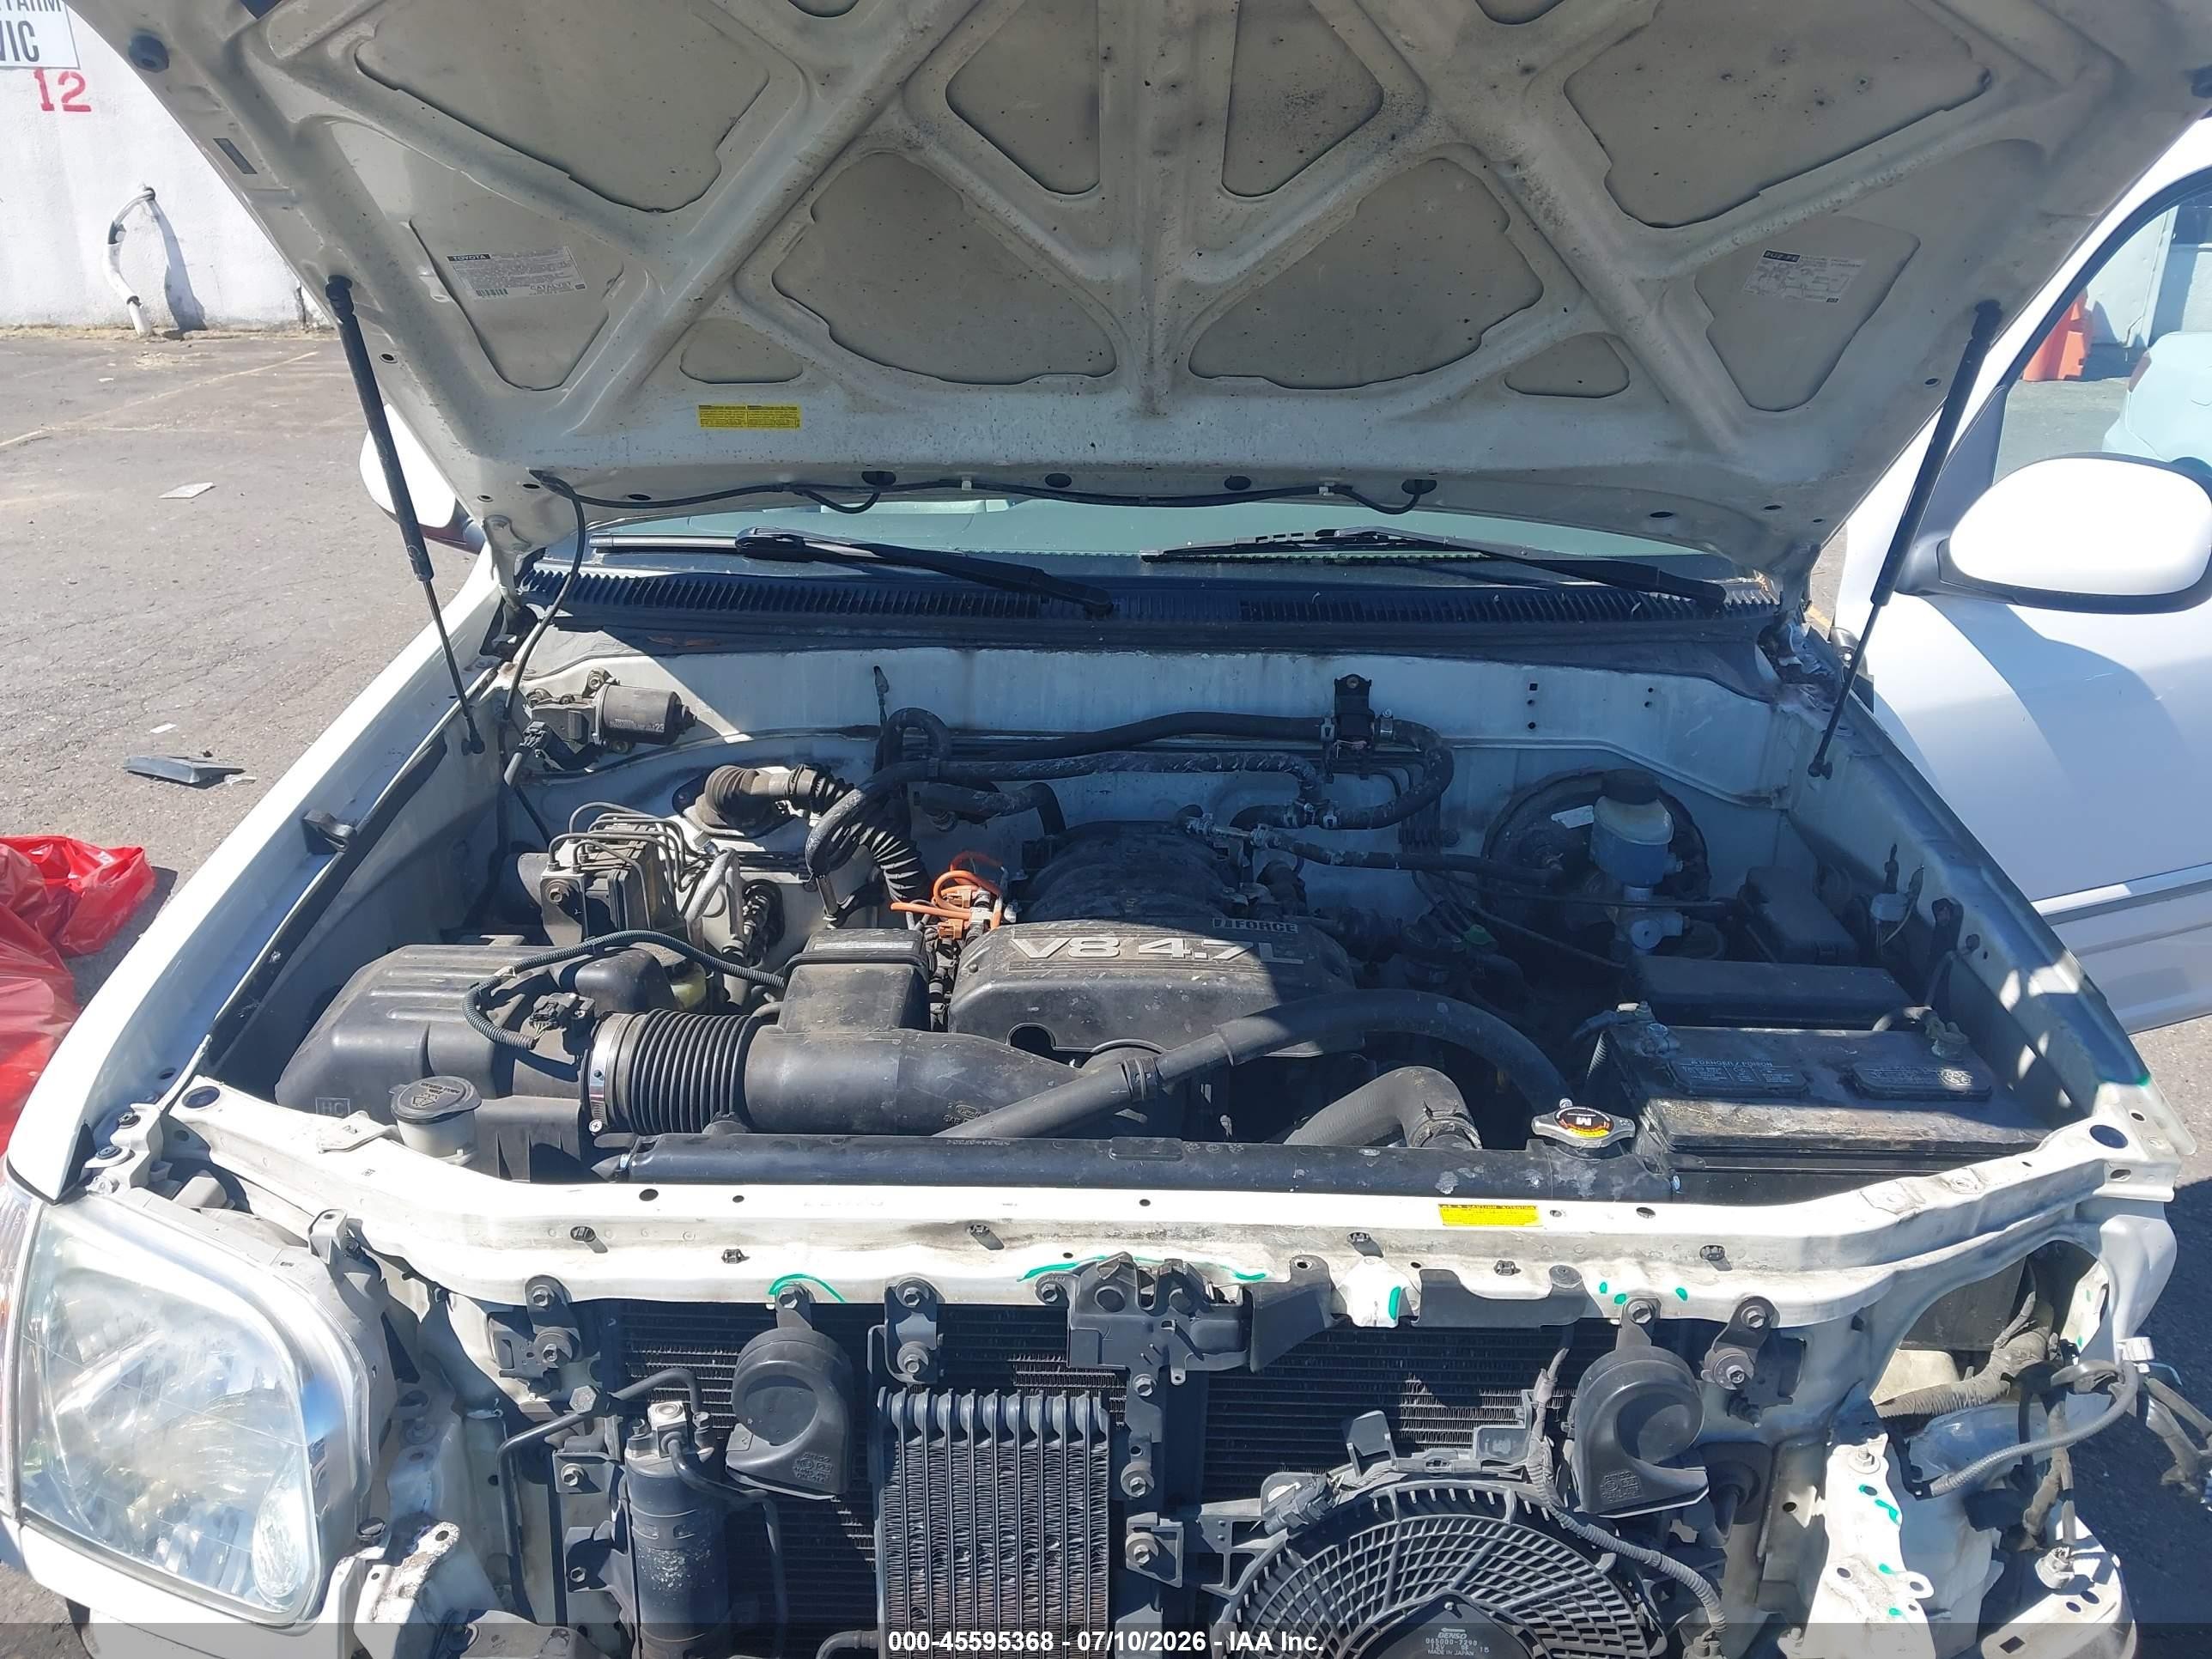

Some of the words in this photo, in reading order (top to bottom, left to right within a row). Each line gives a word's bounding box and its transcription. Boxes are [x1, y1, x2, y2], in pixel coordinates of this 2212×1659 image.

[33, 69, 91, 112] 12
[1012, 937, 1121, 958] V8
[1138, 939, 1304, 965] 4.7L
